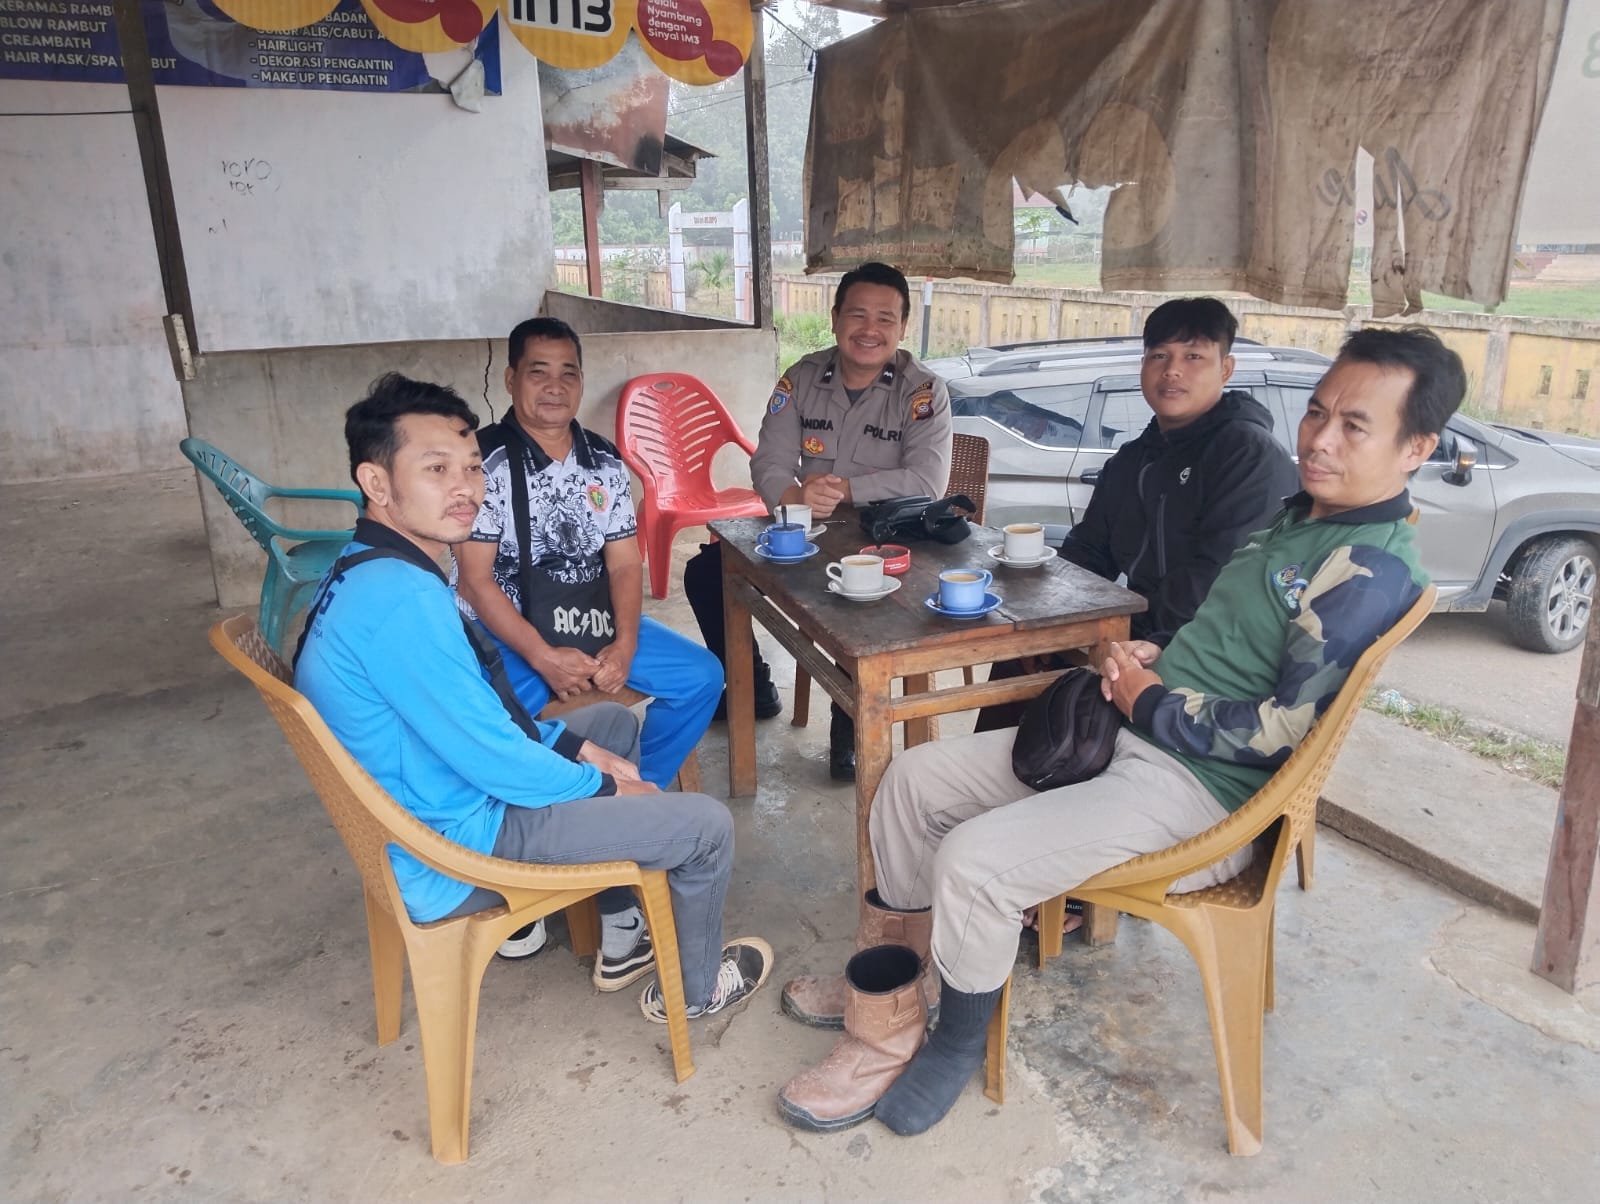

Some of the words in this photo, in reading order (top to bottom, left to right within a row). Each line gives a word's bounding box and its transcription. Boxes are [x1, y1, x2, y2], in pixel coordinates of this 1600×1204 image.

[70, 4, 114, 16] RAMB
[647, 5, 702, 27] Nyambung
[1, 17, 42, 29] BLOW
[47, 19, 107, 32] RAMBUT
[648, 17, 687, 32] dengan
[2, 34, 91, 49] CREAMBATH
[648, 28, 679, 40] Sinyal
[257, 40, 323, 52] HAIRLIGHT
[5, 51, 40, 63] HAIR
[44, 53, 118, 67] MASK/SPA
[259, 55, 321, 68] DEKORASI
[324, 58, 394, 71] PENGANTIN
[261, 71, 296, 83] MAKE
[300, 74, 315, 83] UP
[318, 73, 388, 86] PENGANTIN
[863, 423, 902, 441] POLRI
